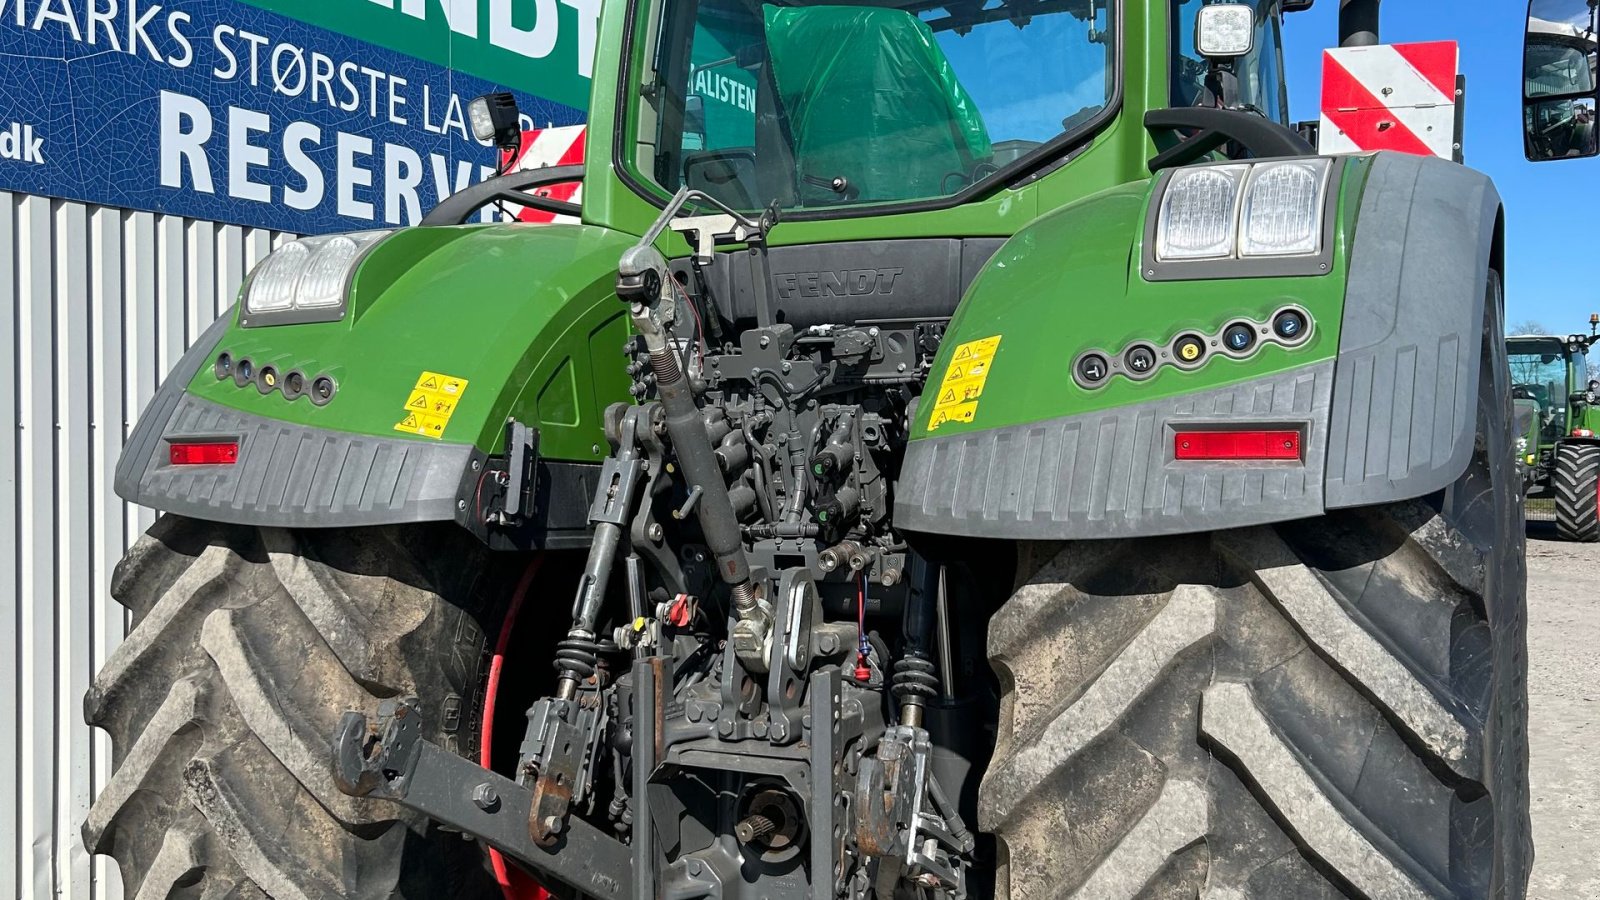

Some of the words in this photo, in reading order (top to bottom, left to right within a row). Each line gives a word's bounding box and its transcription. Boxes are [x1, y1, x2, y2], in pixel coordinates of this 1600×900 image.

[0, 0, 193, 68] ARKS
[213, 24, 408, 126] STØRSTE
[774, 267, 904, 299] FENDT
